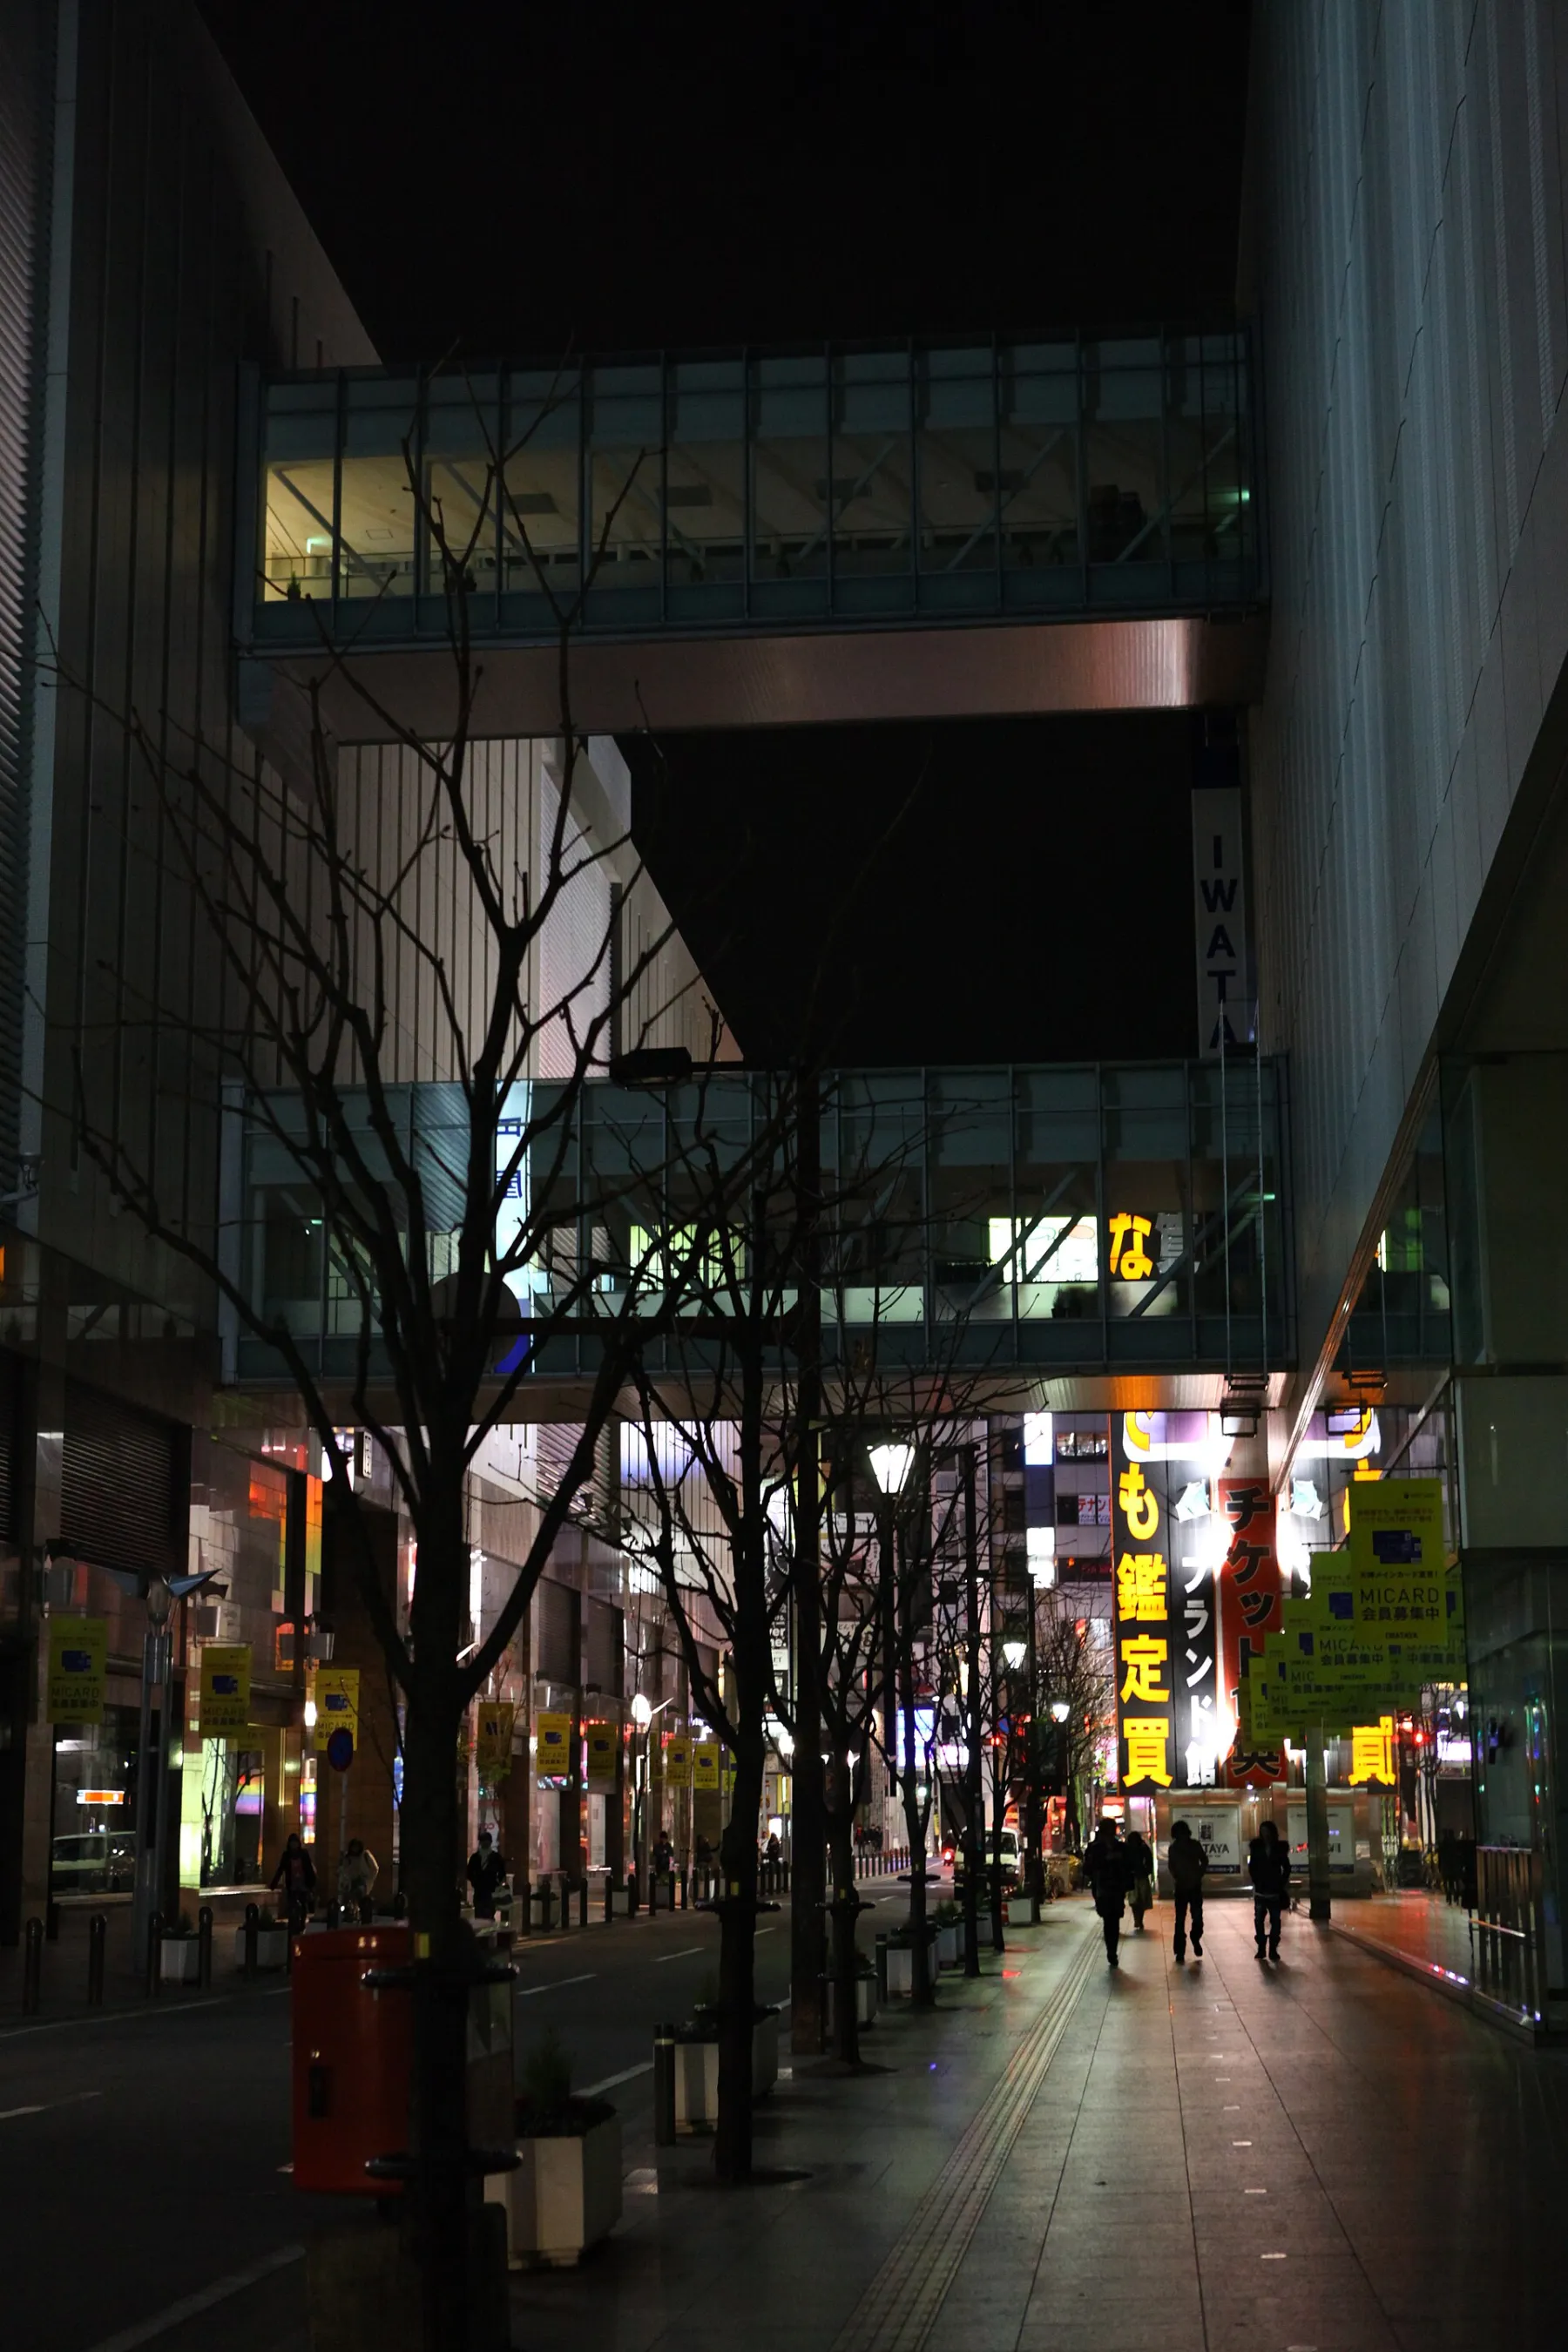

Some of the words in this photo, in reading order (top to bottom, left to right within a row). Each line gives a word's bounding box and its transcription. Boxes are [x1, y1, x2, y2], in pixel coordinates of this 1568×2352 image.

[1109, 1213, 1153, 1280] な
[1360, 1587, 1439, 1604] MICARD
[1361, 1605, 1440, 1621] 会員募集中
[1290, 1670, 1315, 1682] MIC
